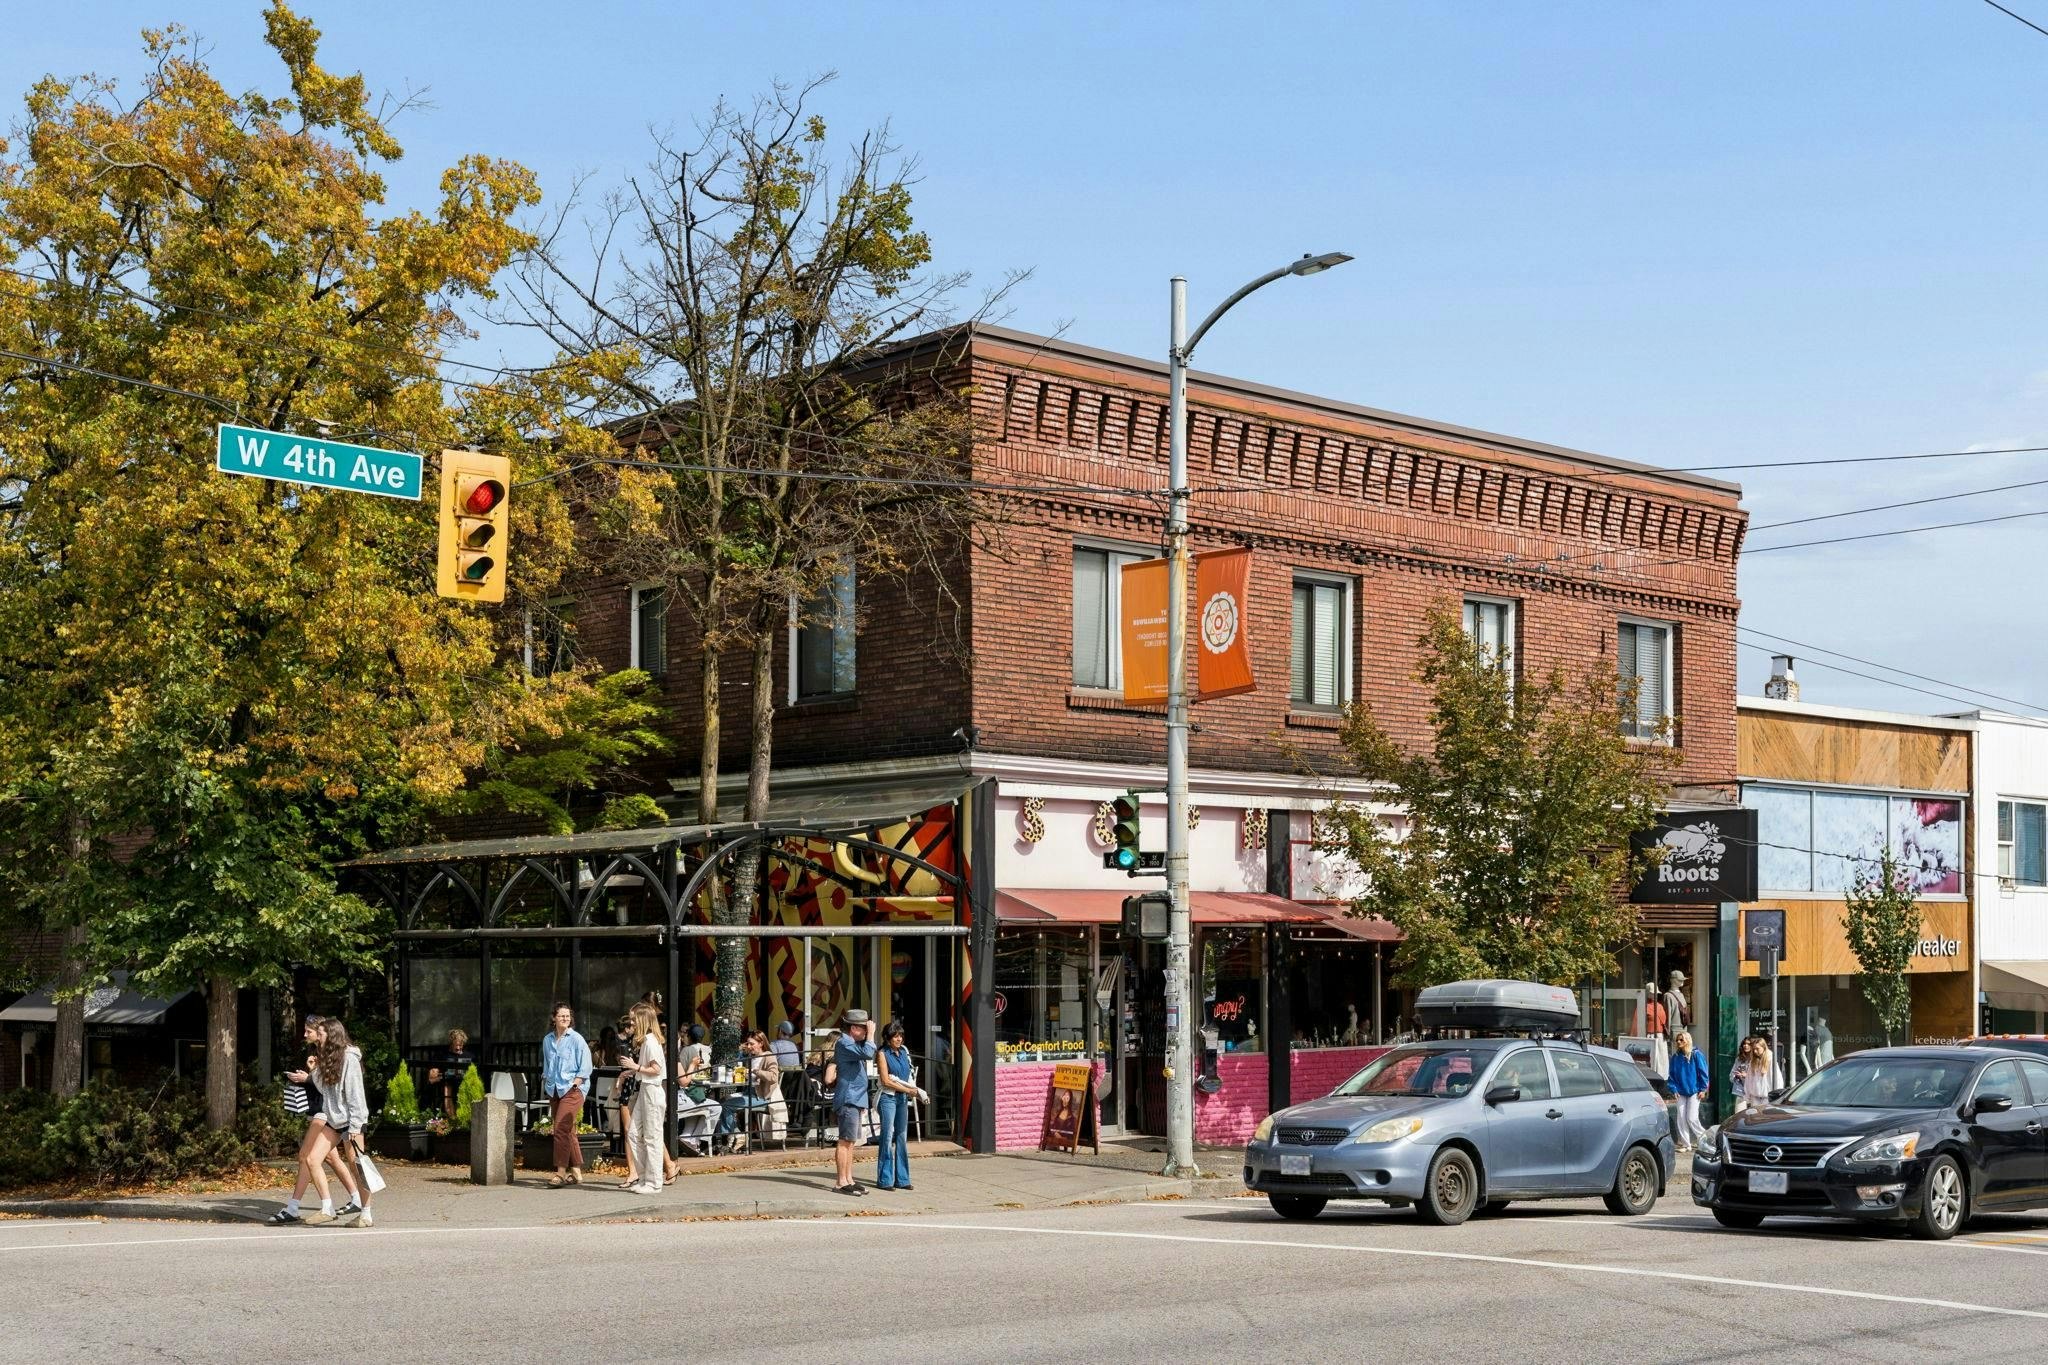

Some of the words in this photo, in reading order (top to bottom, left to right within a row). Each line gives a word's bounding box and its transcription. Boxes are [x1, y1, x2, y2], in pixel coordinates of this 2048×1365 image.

[237, 435, 270, 468] W
[283, 445, 336, 479] 4th
[350, 454, 405, 489] Ave
[1658, 864, 1719, 882] Roots
[1760, 1009, 1771, 1019] your
[1024, 1041, 1060, 1053] Comfort
[1062, 1040, 1084, 1051] Food
